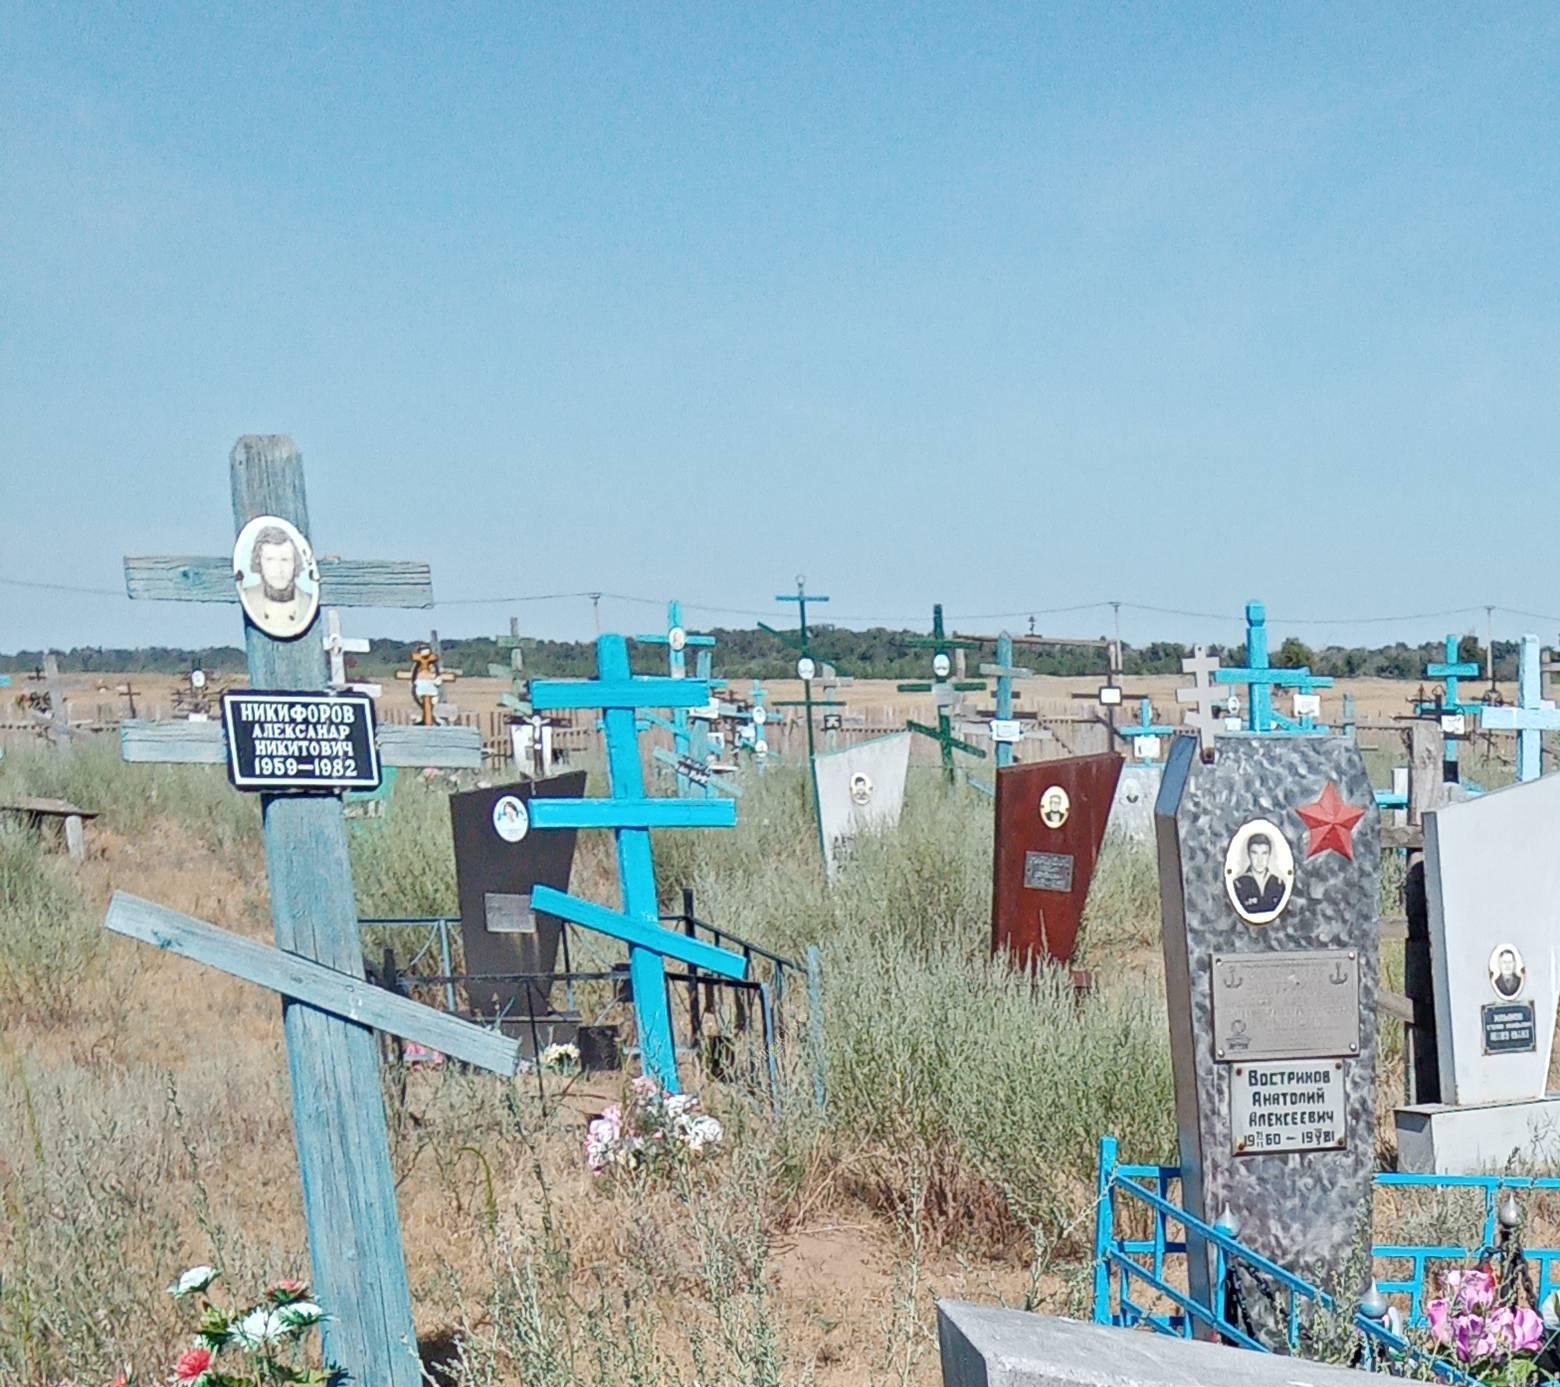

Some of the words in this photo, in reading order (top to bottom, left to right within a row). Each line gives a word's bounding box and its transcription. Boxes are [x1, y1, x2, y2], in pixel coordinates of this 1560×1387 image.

[240, 703, 355, 723] НИКИФОРОВ
[252, 723, 350, 739] АЛЕКСАНДР
[254, 740, 354, 756] НИКИТОВИЧ
